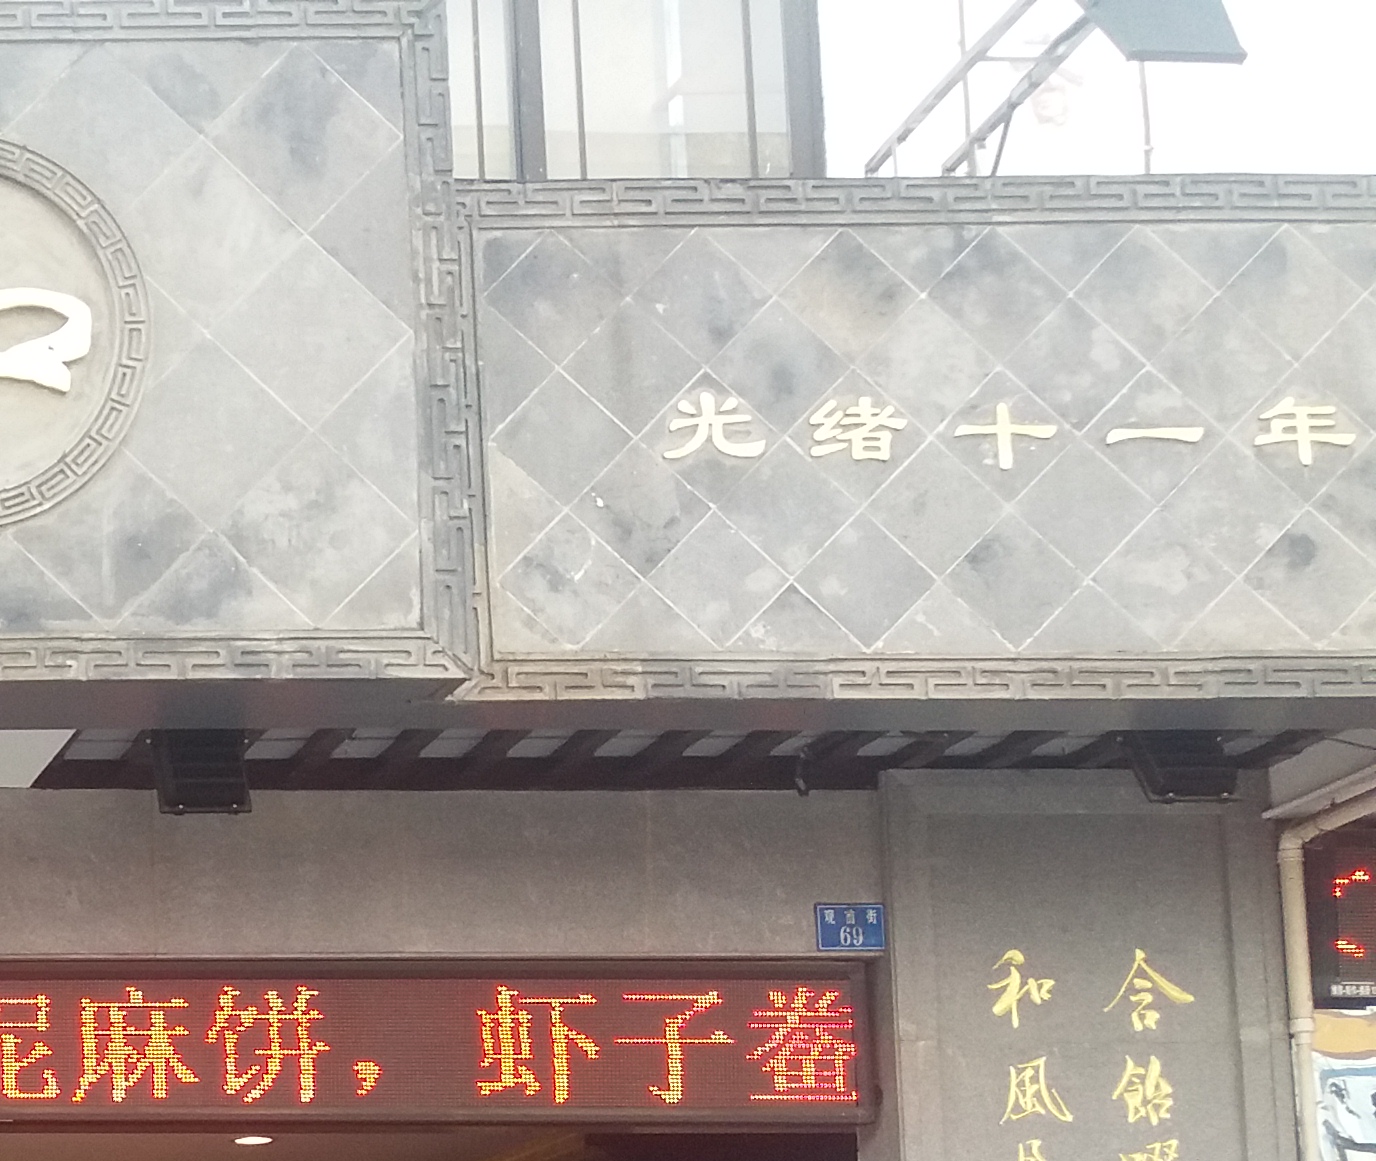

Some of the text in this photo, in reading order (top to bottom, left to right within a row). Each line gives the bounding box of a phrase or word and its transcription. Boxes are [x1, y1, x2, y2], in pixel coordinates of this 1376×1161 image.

[662, 391, 1358, 470] 光绪十一年
[839, 925, 864, 947] 69
